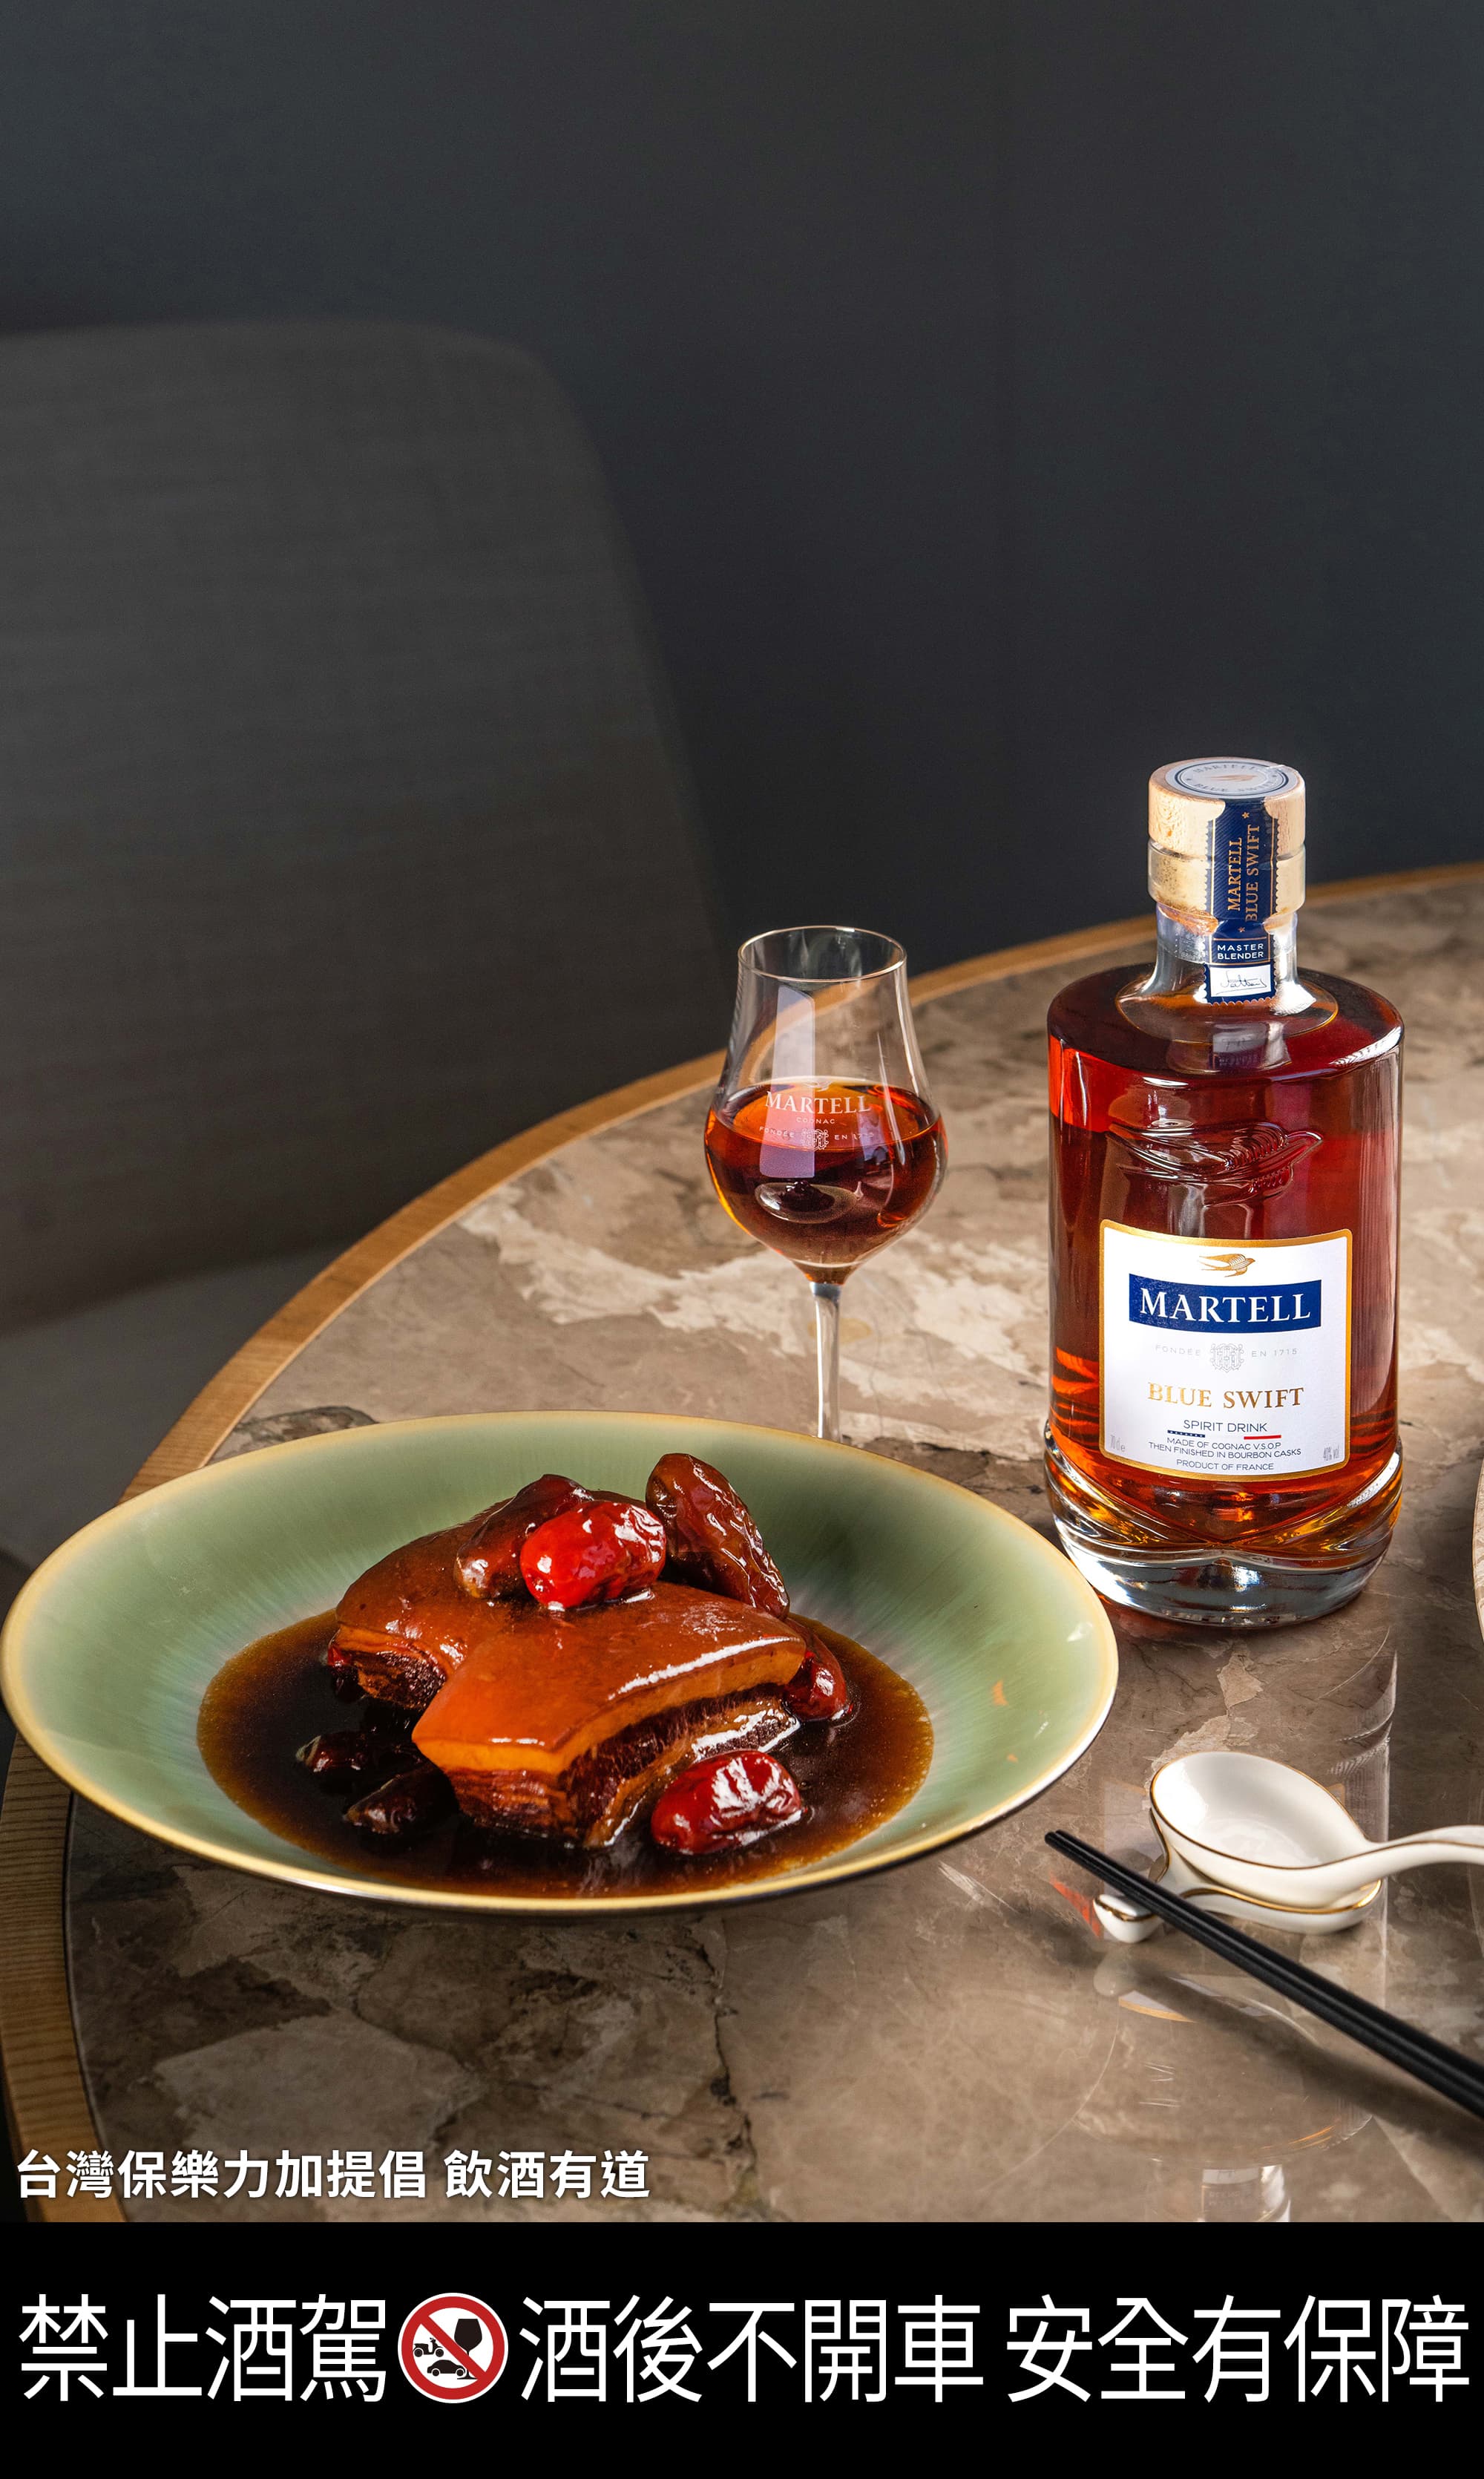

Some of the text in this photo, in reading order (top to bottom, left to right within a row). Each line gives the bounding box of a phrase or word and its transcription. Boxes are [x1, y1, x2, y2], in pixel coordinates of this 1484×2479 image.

[1228, 837, 1242, 911] MARTELL
[1245, 825, 1260, 921] BLUE SWIFT
[1217, 943, 1264, 952] MASTER
[1218, 952, 1264, 960] BLENDER
[765, 1091, 873, 1115] MARTELL
[1140, 1287, 1311, 1323] MARTELL
[1273, 1348, 1298, 1356] 1715
[1147, 1382, 1304, 1409] BLUE SWIFT
[1183, 1419, 1267, 1432] SPIRIT DRINK
[1167, 1437, 1194, 1447] MADE
[1149, 1441, 1172, 1453] THEN
[1174, 1447, 1215, 1458] FINISHED
[1228, 1451, 1272, 1459] BOURBON
[1274, 1448, 1301, 1458] CASKS
[1177, 1459, 1219, 1470] PRODUCT
[1236, 1463, 1274, 1471] FRANCE
